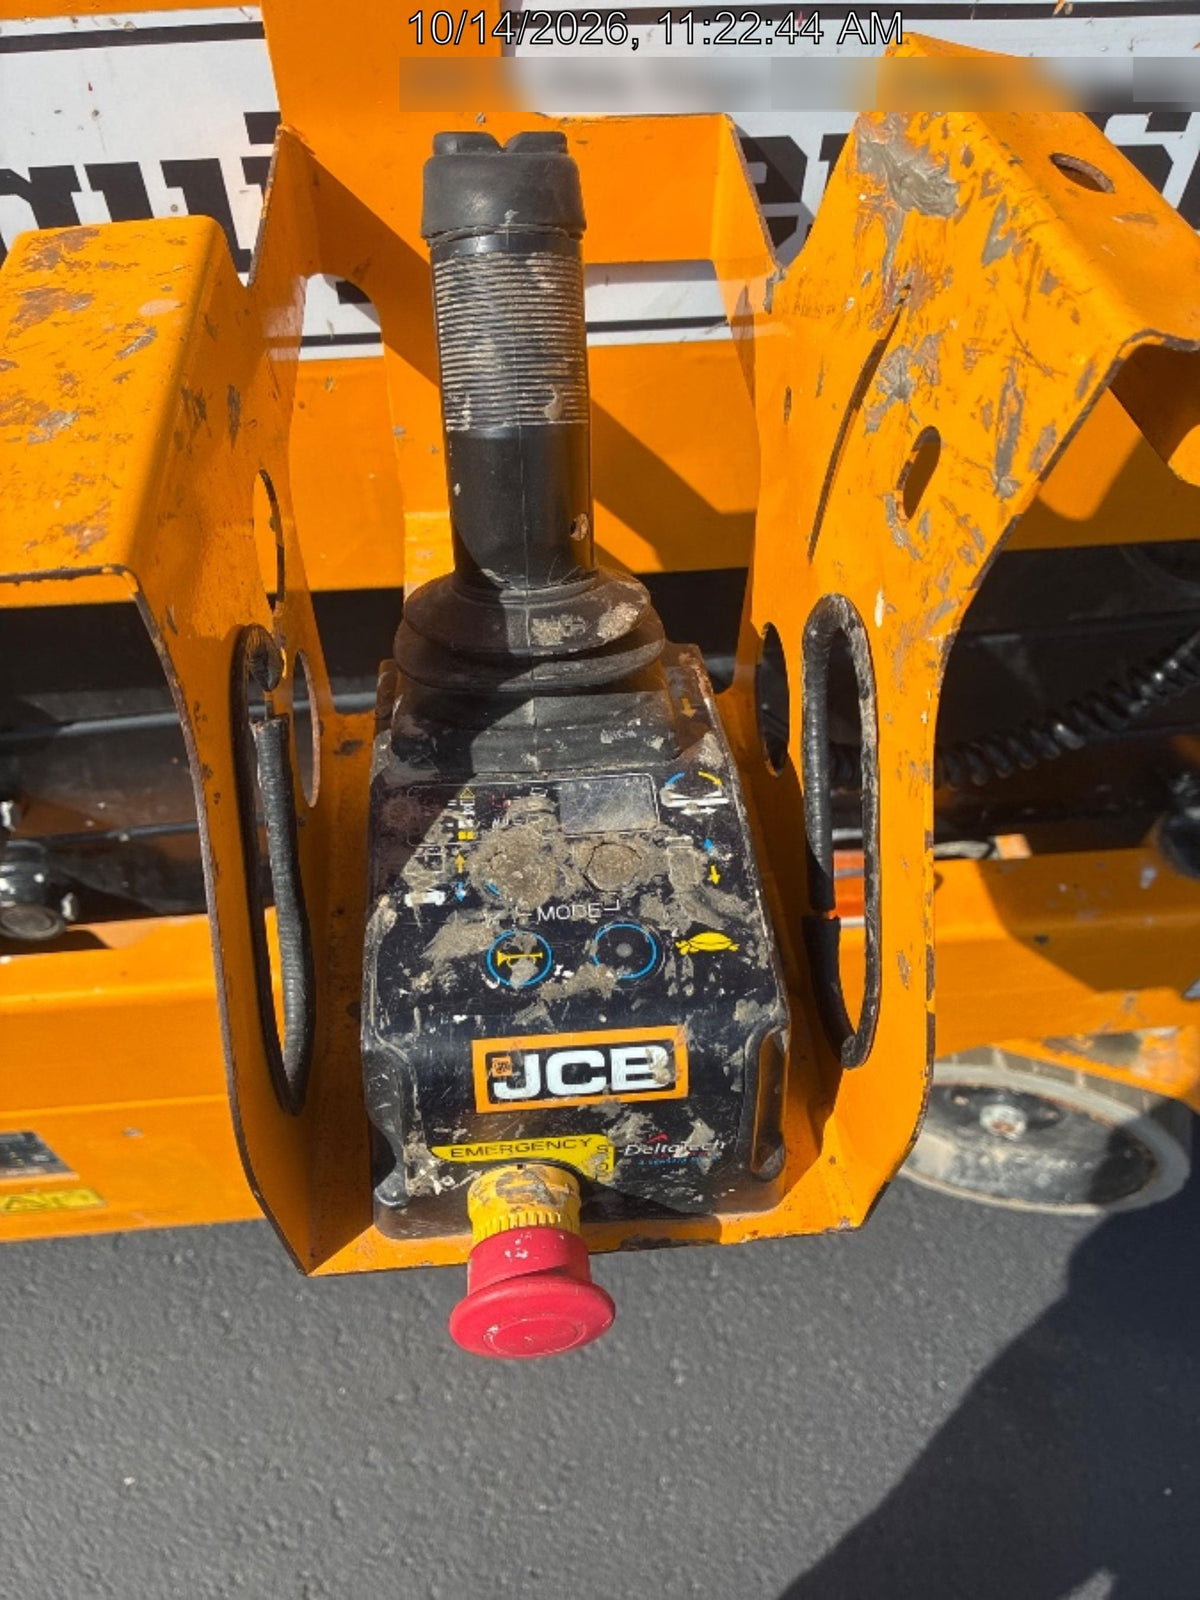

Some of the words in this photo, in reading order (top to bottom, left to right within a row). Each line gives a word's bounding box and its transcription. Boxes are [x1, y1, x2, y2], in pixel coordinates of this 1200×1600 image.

[536, 902, 602, 921] MODE
[493, 1045, 670, 1100] JCB
[450, 1138, 593, 1158] EMERGENCY
